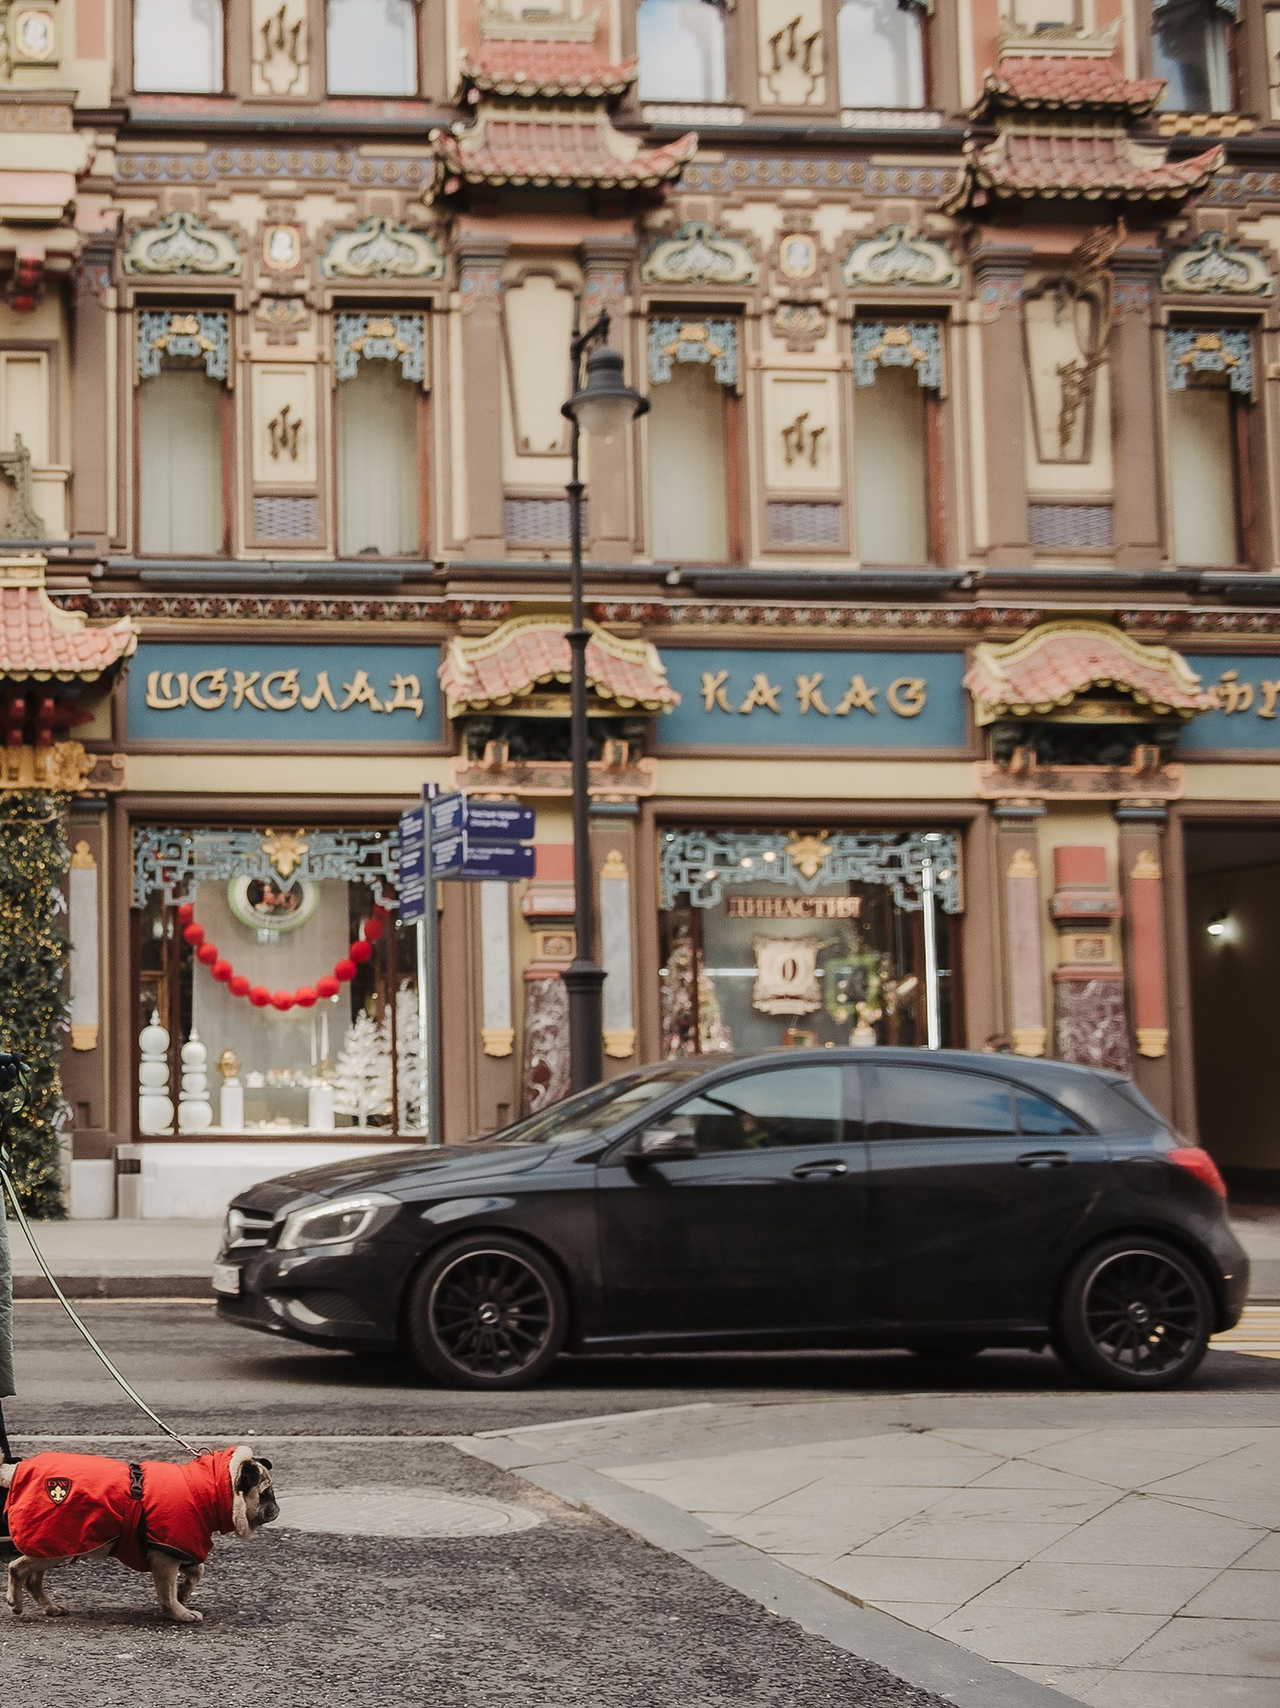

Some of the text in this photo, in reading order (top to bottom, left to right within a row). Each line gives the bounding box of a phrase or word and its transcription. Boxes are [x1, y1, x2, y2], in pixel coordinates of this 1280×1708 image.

[146, 668, 424, 718] ШОКОЛАД
[700, 669, 927, 718] КАКАО
[727, 896, 861, 918] ДИНАСТИЯ
